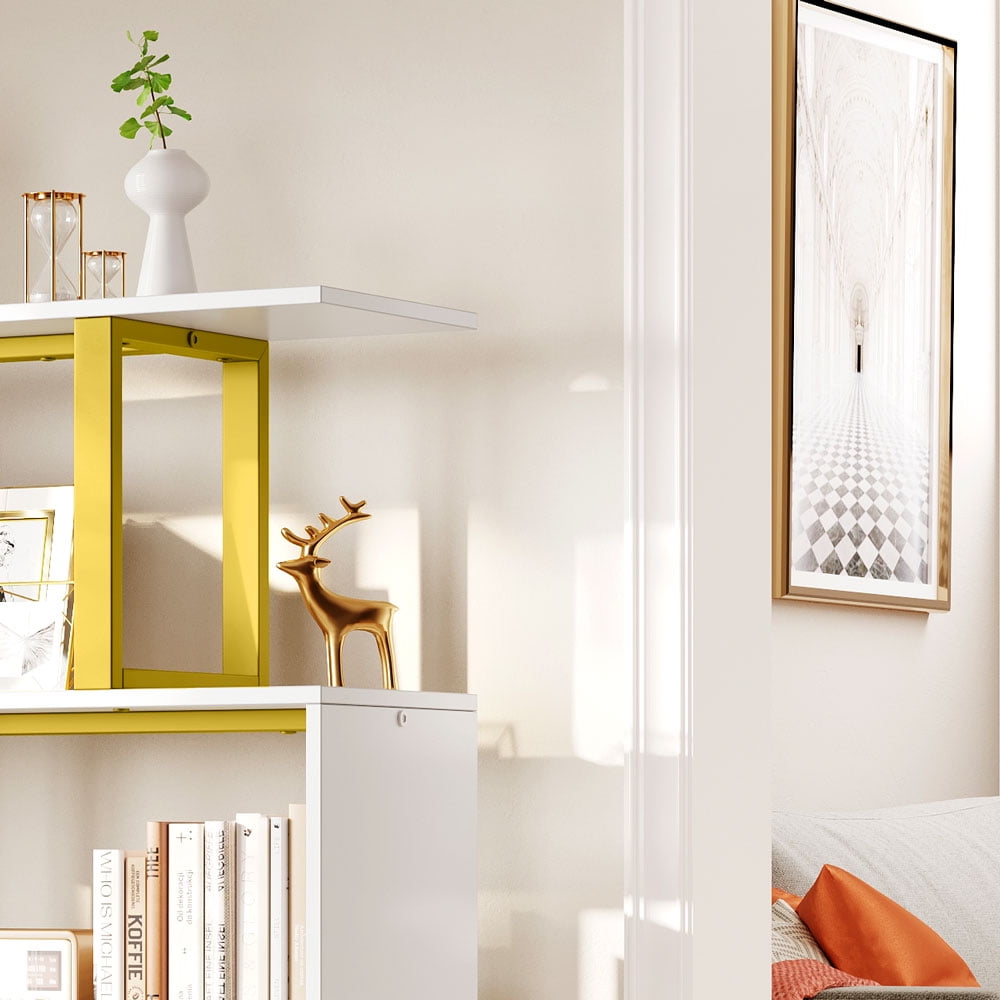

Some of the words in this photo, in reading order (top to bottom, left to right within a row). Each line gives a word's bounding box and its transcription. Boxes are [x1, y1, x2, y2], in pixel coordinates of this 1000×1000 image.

[100, 851, 113, 898] WHO
[146, 847, 160, 878] THEE
[100, 902, 113, 918] IS
[127, 914, 143, 981] KOFFIE
